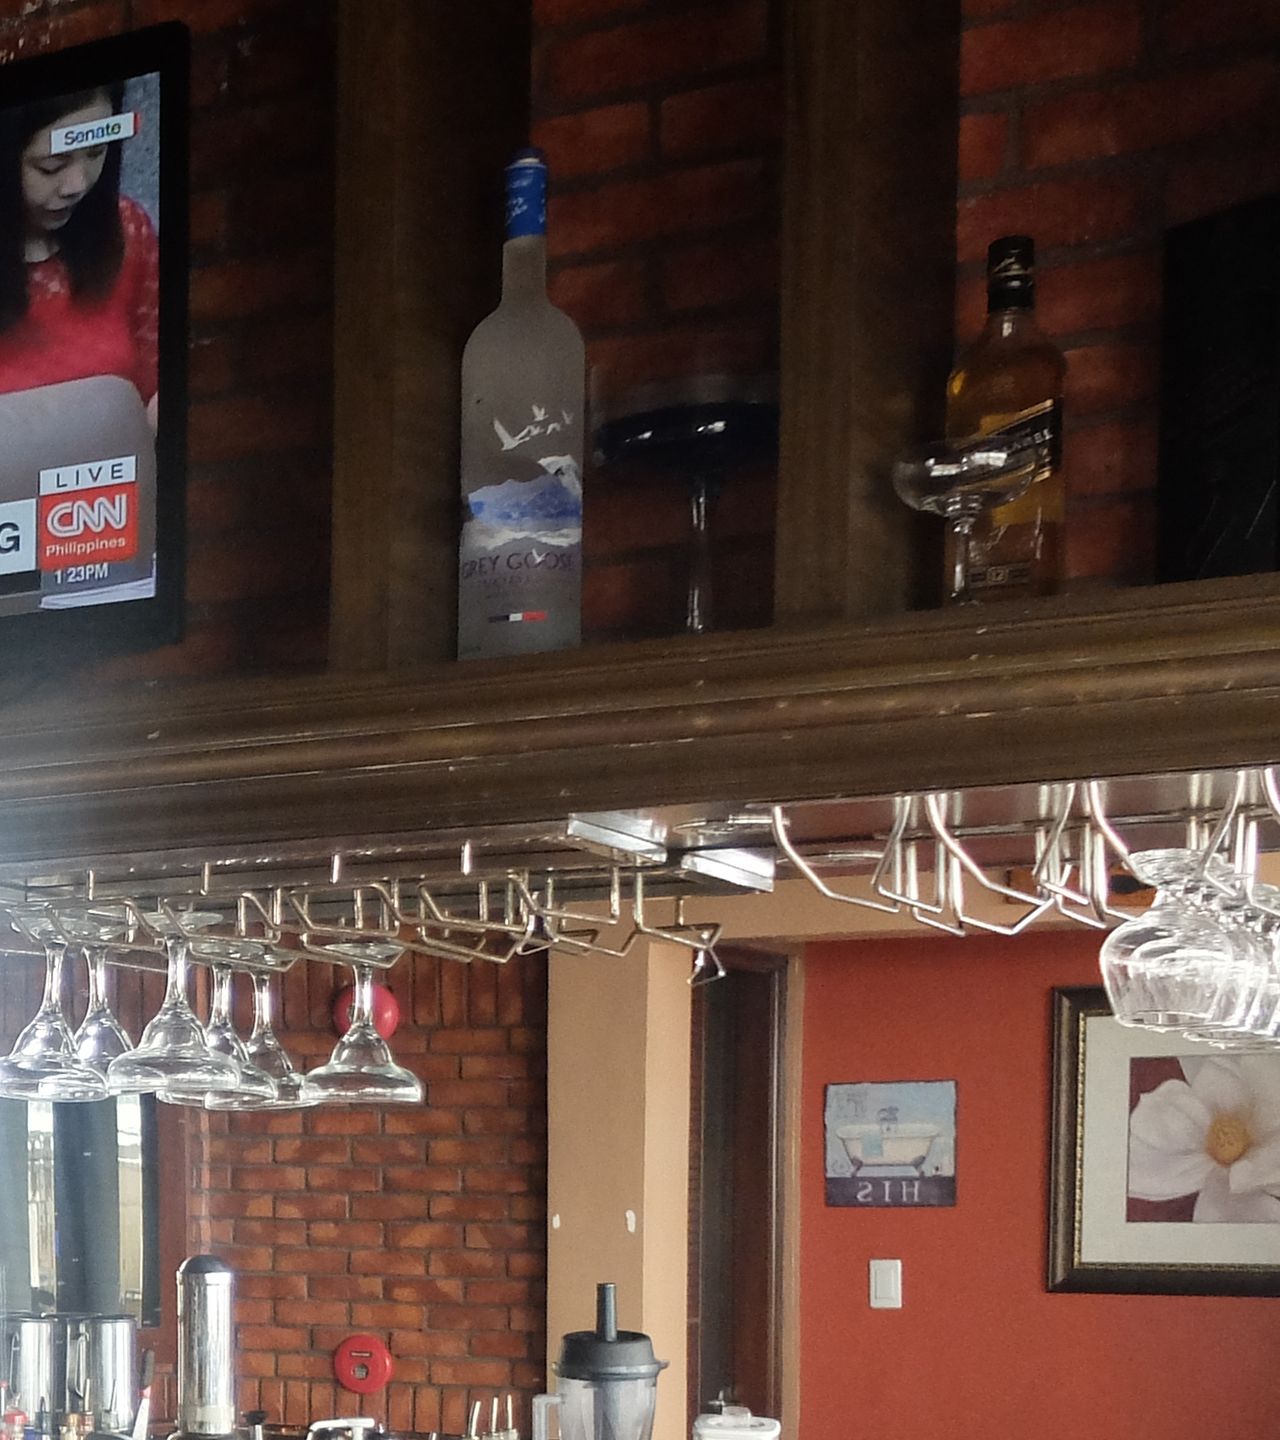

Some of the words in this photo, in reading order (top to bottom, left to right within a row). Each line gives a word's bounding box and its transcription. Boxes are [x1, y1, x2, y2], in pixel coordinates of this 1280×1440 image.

[64, 122, 122, 146] Senate
[56, 463, 123, 488] LIVE
[47, 493, 127, 537] CNN
[45, 537, 126, 558] Philippines
